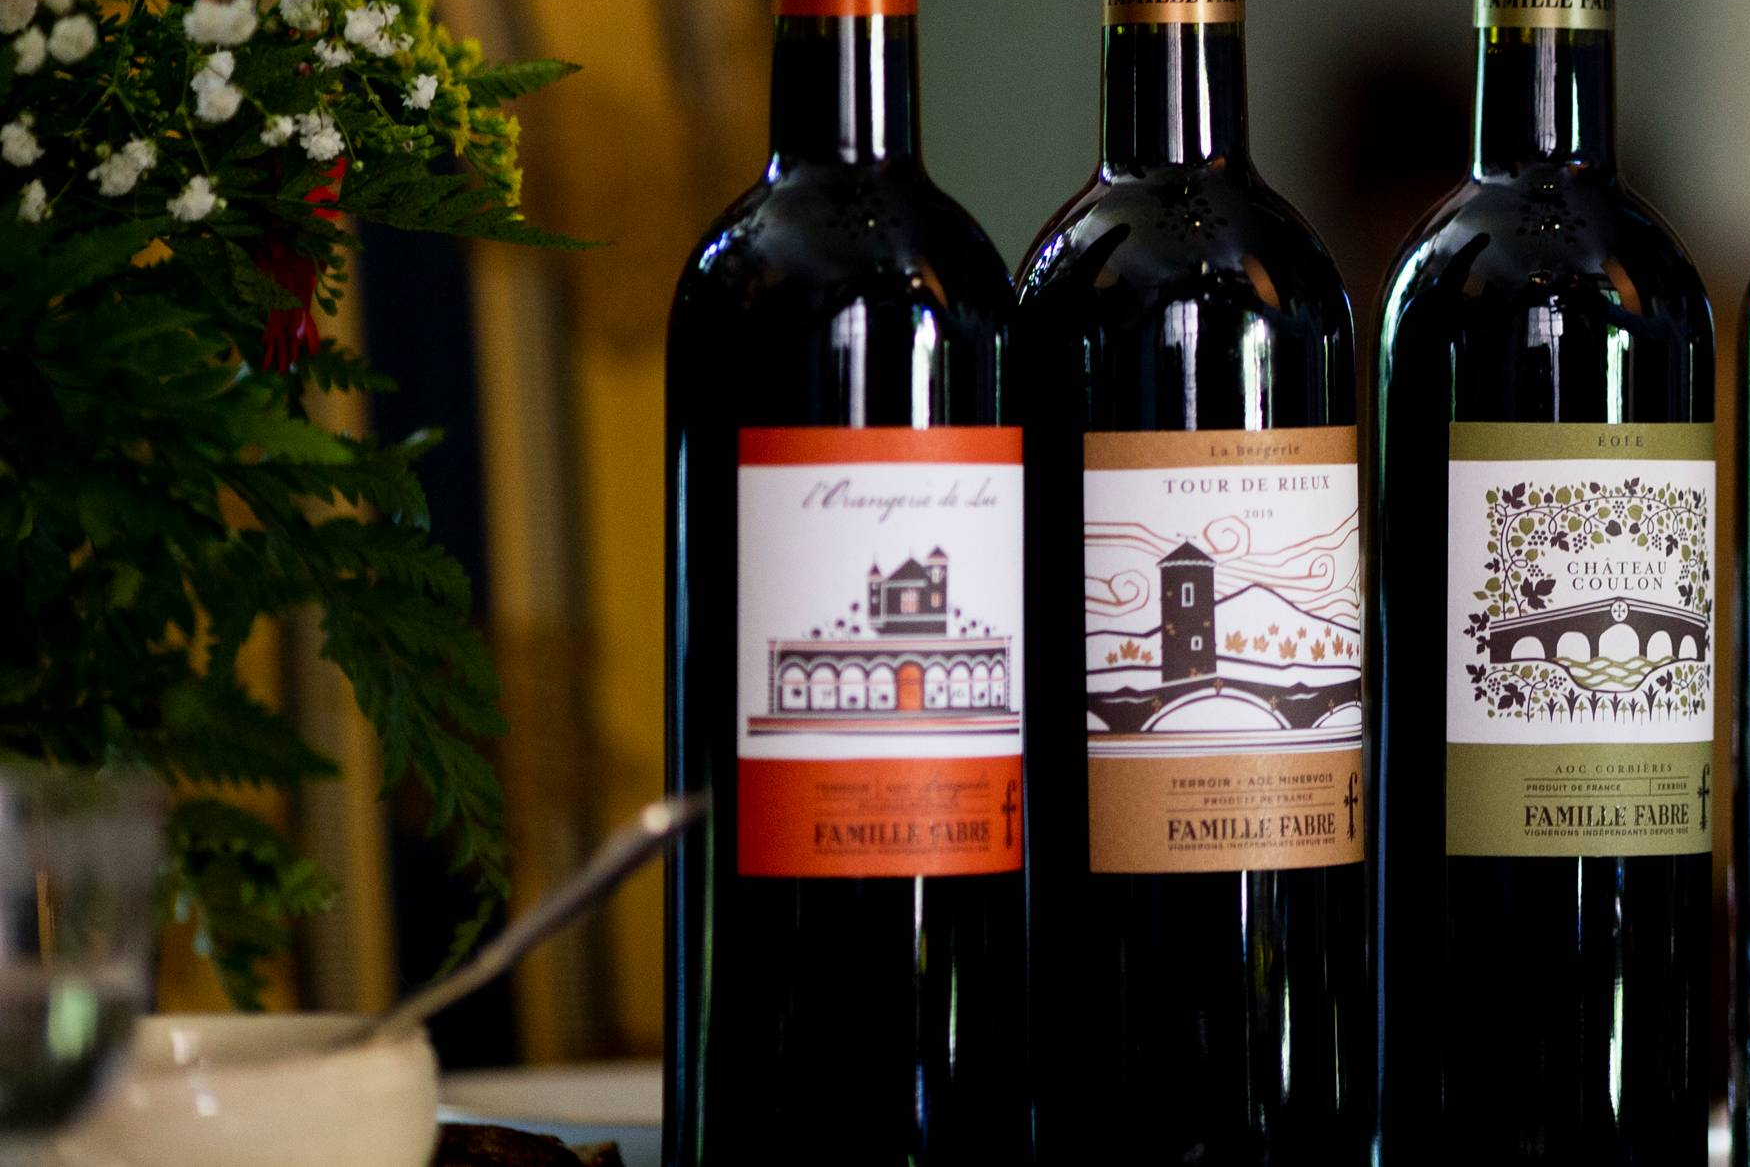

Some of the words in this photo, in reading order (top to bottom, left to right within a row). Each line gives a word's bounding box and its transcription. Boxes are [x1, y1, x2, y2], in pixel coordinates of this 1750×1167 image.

[1163, 478, 1230, 494] TOUR
[1241, 477, 1269, 492] DE
[1278, 474, 1330, 490] RIEUX
[1567, 556, 1667, 574] CHÂTEAU
[1572, 577, 1663, 591] COULON
[1555, 765, 1587, 774] AOC
[1171, 778, 1231, 789] TERROIR
[1279, 772, 1334, 785] MINERVOIS
[1526, 784, 1567, 792] PRODUIT
[1571, 784, 1583, 792] DE
[1586, 783, 1621, 792] FRANCE
[1524, 805, 1627, 827] FAMILLE
[1634, 804, 1689, 825] FABRE
[814, 821, 920, 846] FAMILLE
[929, 819, 991, 844] FABRE
[1167, 817, 1272, 842] FAMILLE
[1280, 812, 1336, 837] FABRE
